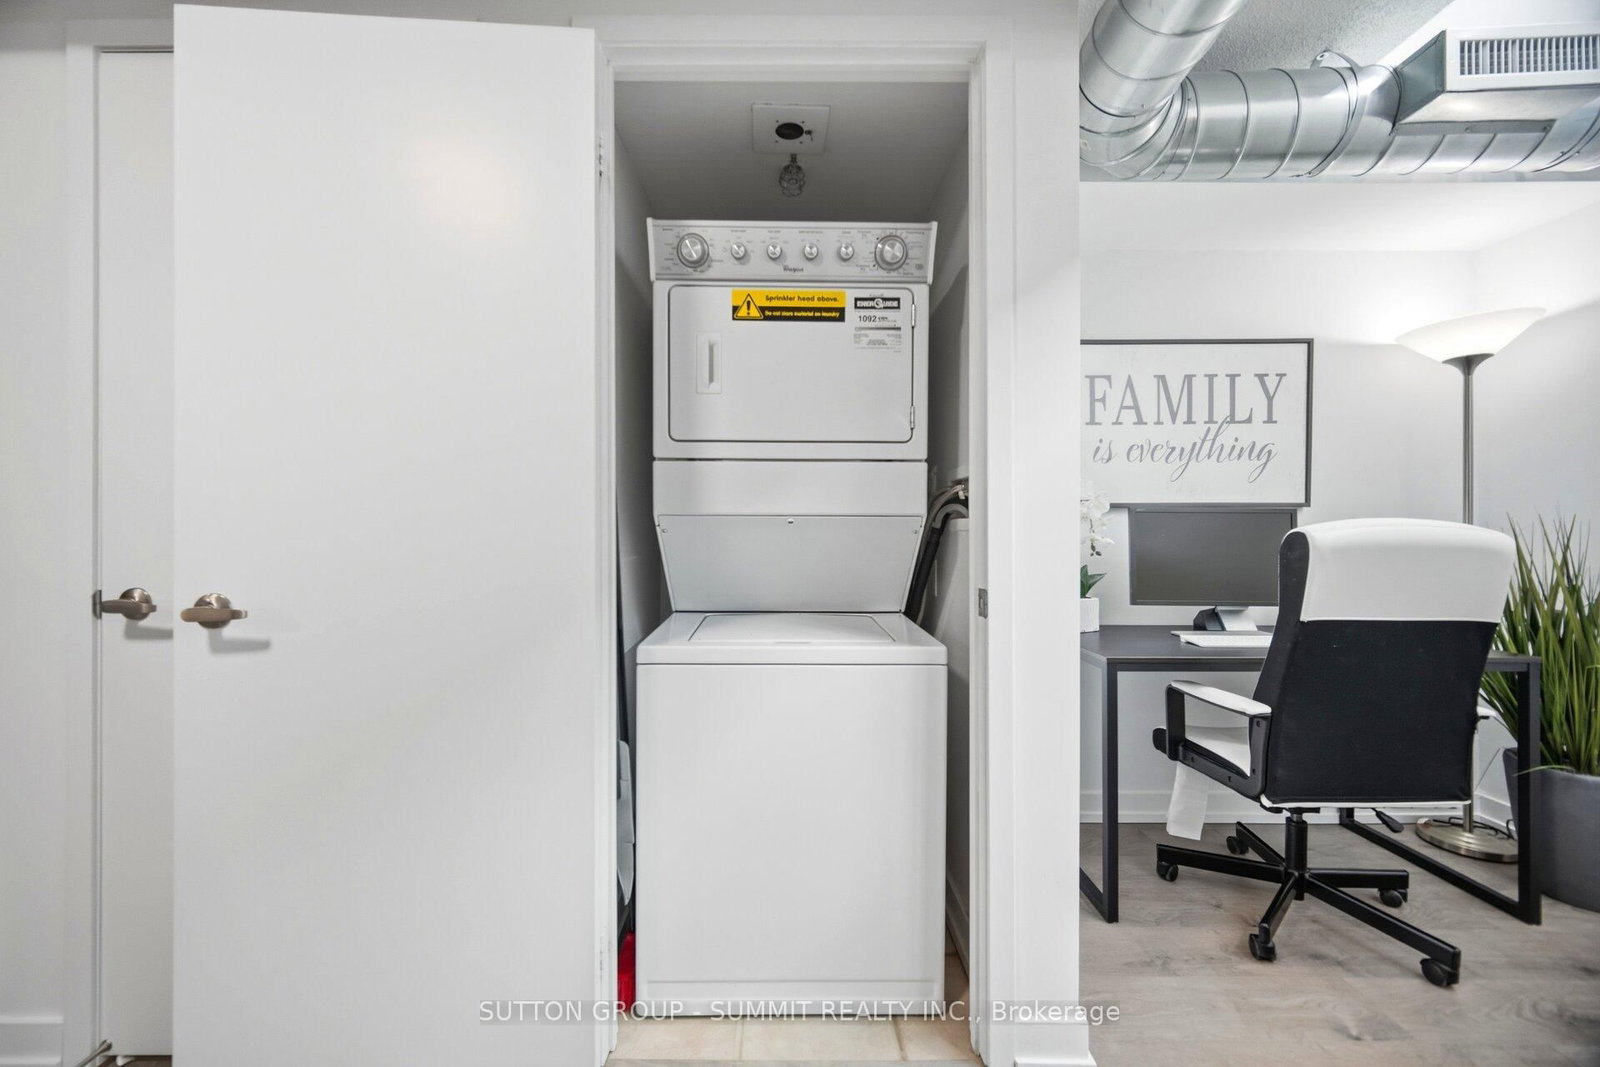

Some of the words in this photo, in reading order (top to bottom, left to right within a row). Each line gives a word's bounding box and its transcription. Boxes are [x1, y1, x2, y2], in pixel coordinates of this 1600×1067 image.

[765, 295, 796, 303] Sprinkler
[1084, 373, 1287, 425] FAMILY
[1092, 438, 1117, 464] is
[1126, 414, 1279, 483] everything
